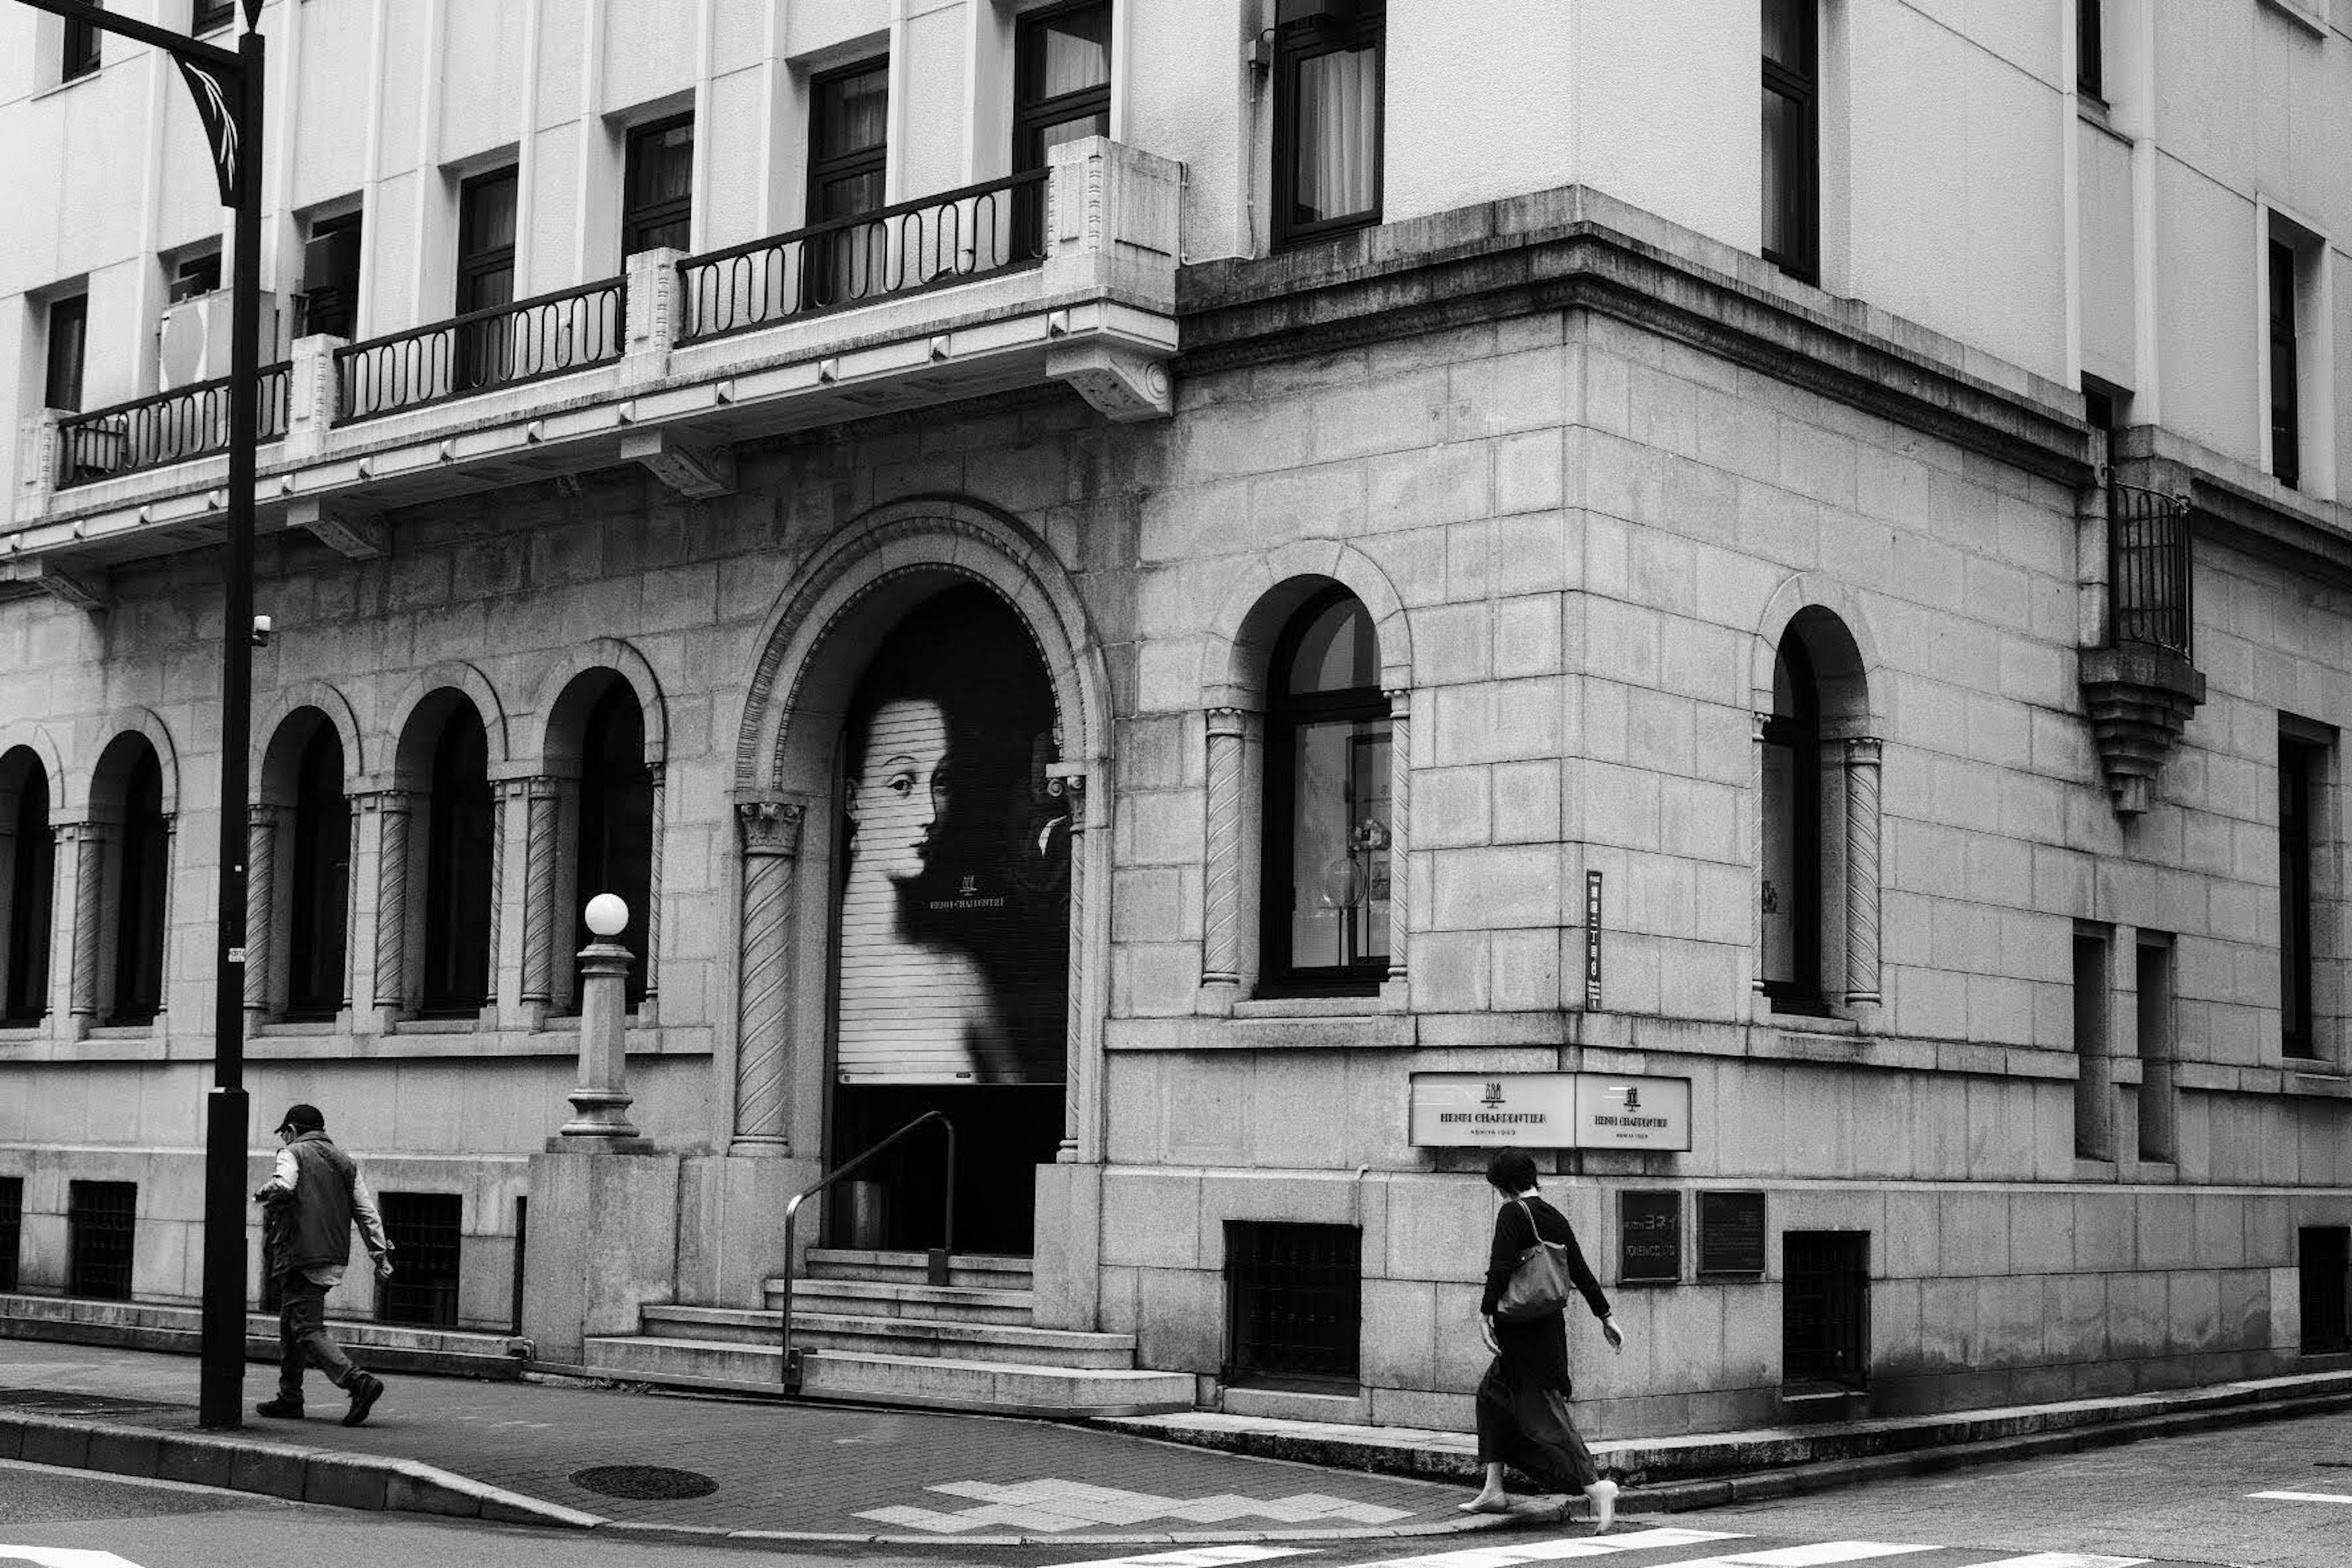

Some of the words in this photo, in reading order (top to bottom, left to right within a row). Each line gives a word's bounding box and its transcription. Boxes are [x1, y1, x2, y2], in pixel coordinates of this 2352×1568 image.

[1440, 1114, 1472, 1123] HENRI
[1475, 1113, 1547, 1124] CHARPENTIER
[1595, 1115, 1618, 1126] HENRI
